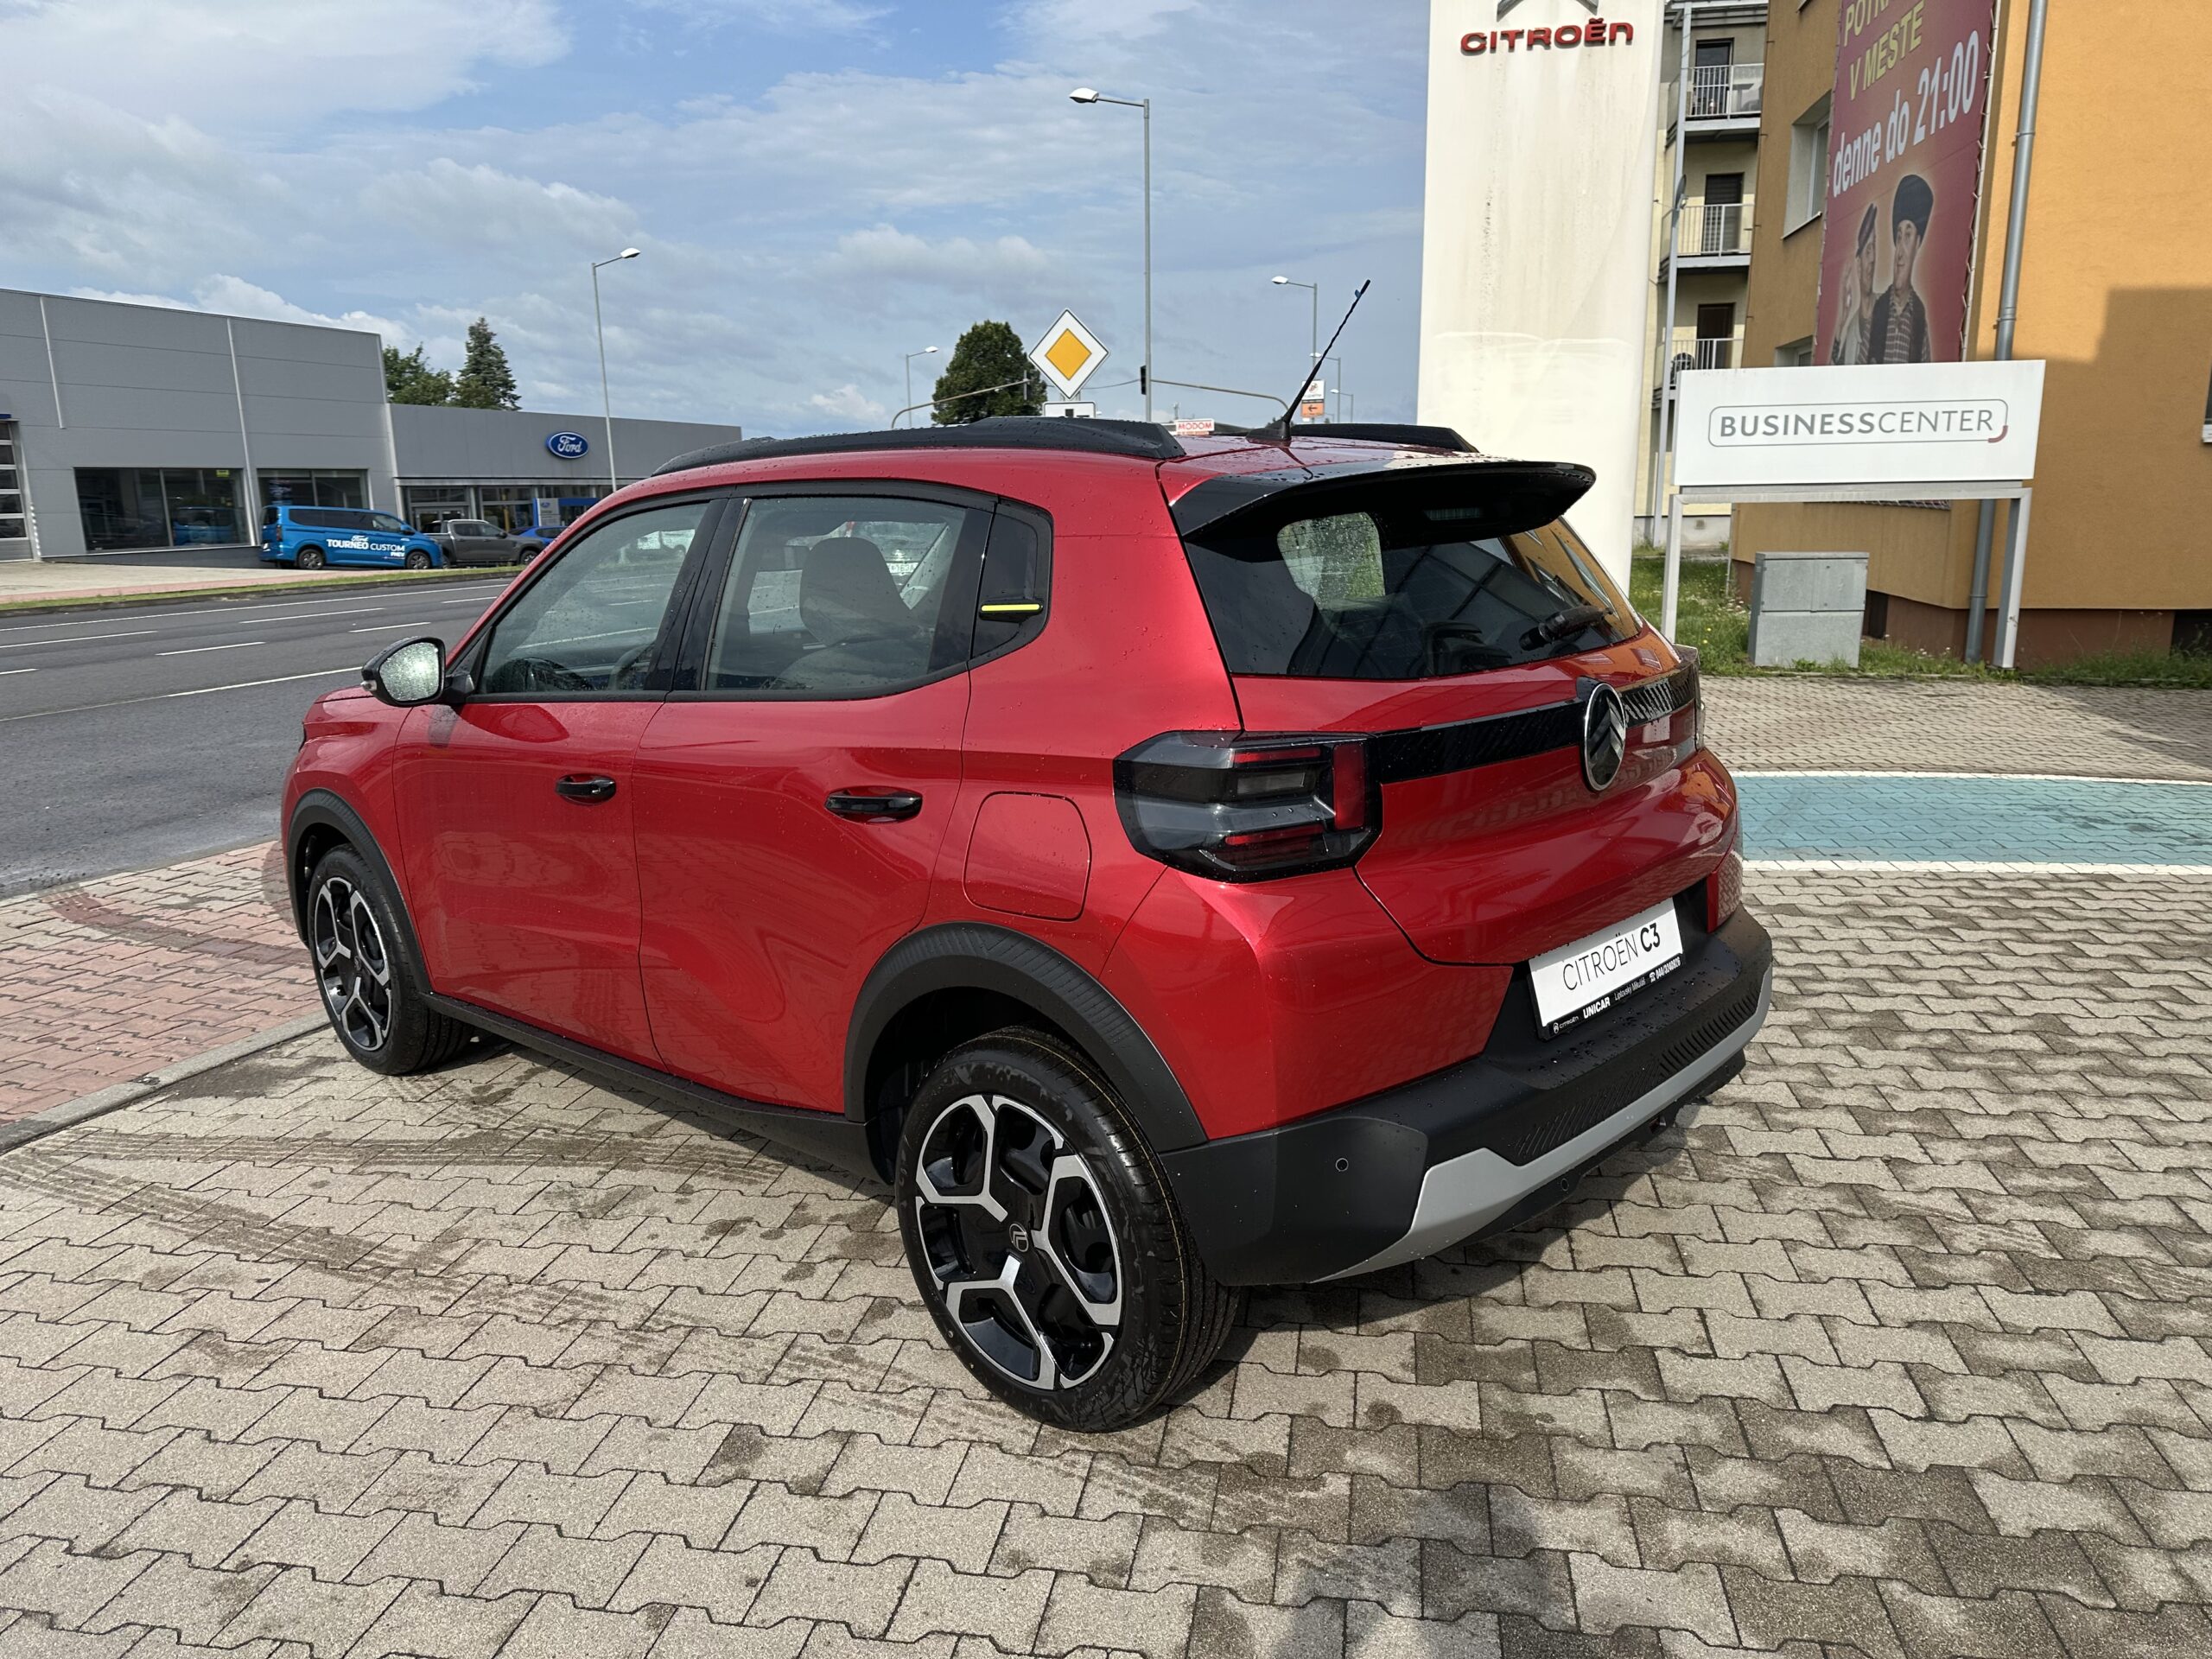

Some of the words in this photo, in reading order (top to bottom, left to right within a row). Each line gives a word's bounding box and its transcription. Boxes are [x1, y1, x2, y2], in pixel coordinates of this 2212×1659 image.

[1460, 17, 1634, 53] CITROËN
[1850, 57, 1861, 101] V
[1863, 0, 1926, 91] MESTE
[1833, 121, 1882, 197] denne
[1886, 89, 1910, 163] do
[1912, 30, 1979, 145] 21:00
[1178, 422, 1212, 430] MODOM
[1719, 409, 1993, 436] BUSINESSCENTER
[557, 435, 582, 453] Ford
[326, 539, 369, 550] TOURNEO
[370, 543, 405, 552] CUSTOM
[1562, 932, 1638, 990] CITROËN
[1640, 923, 1661, 952] C3
[1582, 996, 1611, 1019] UNICAR
